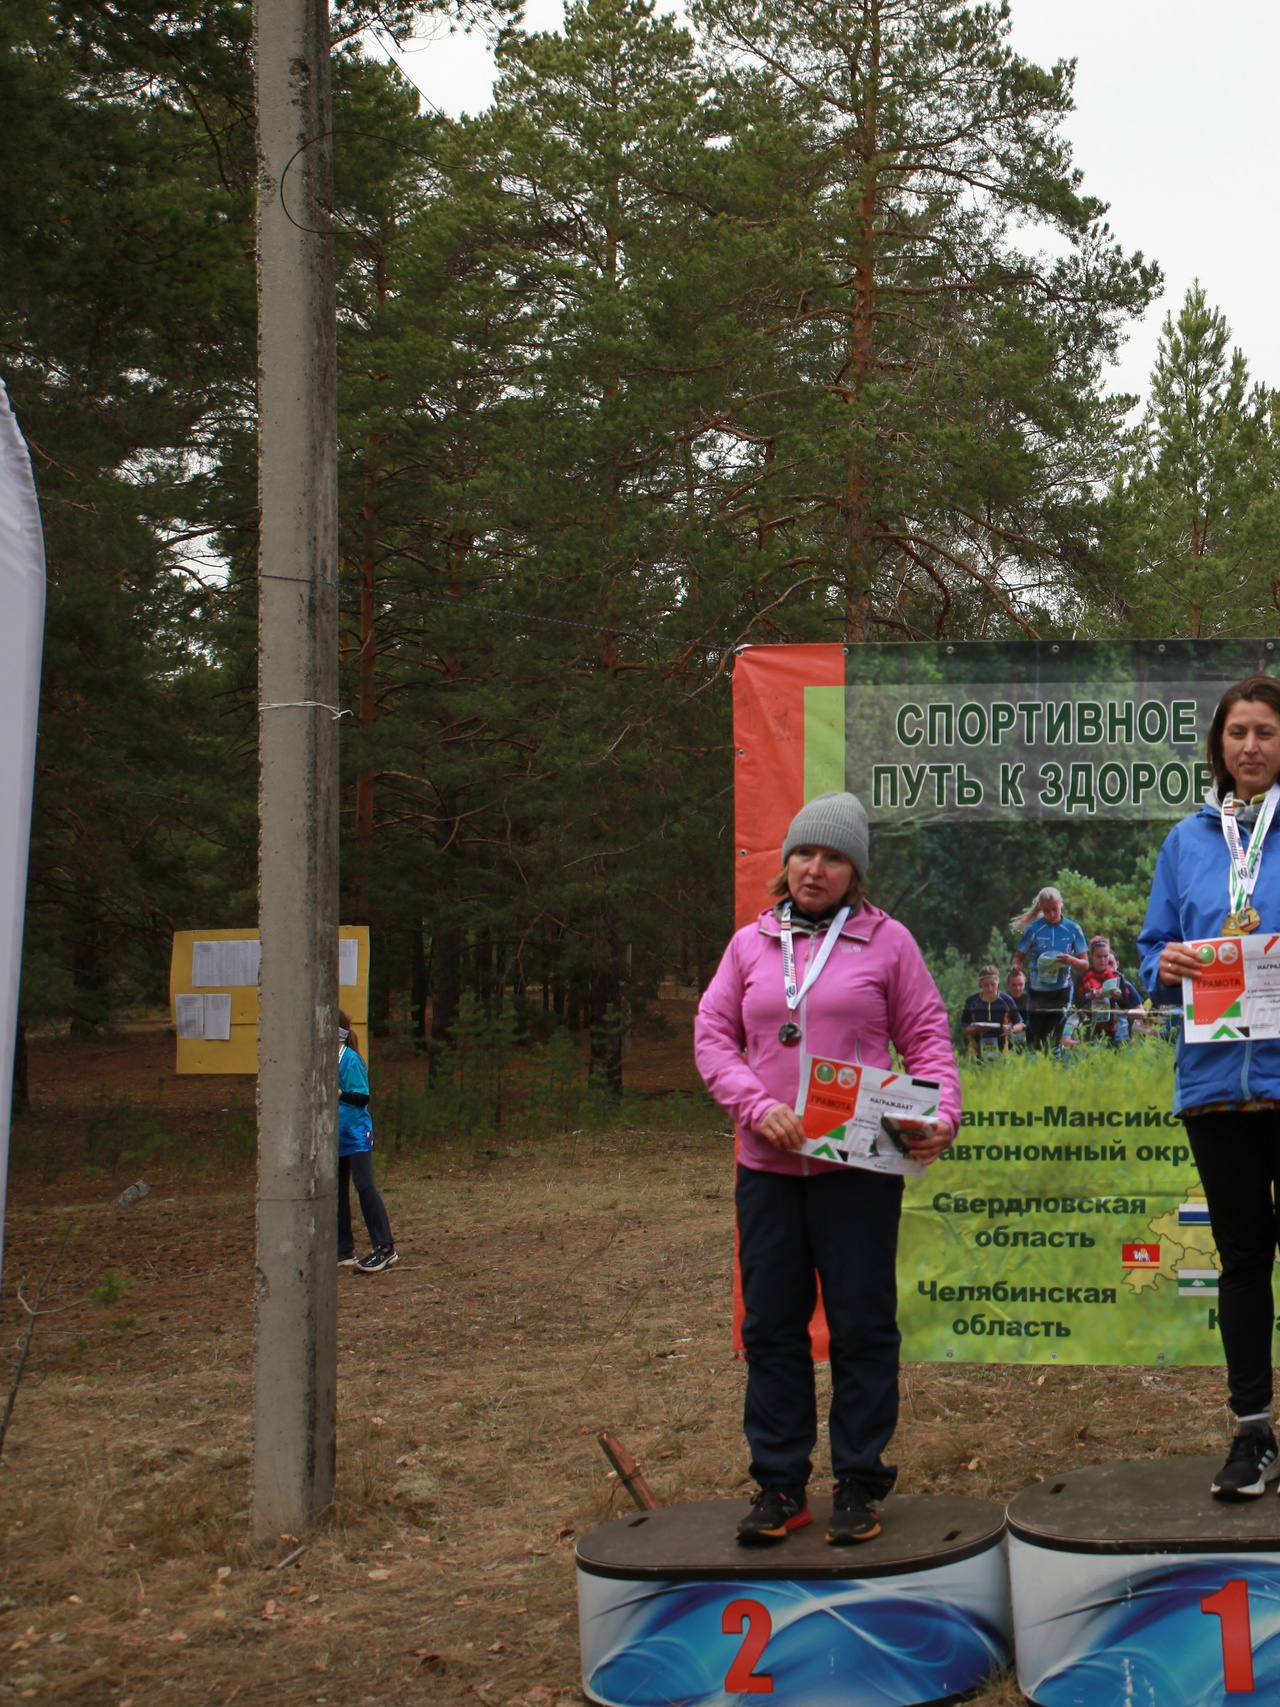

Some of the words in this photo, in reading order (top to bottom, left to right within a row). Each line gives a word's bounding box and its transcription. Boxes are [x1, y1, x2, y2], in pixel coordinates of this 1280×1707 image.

[896, 700, 1198, 747] СПОРТИВНОЕ
[873, 763, 984, 808] ПУТЬ
[1000, 762, 1025, 807] К
[1196, 978, 1241, 988] ГРАМОТА
[810, 1095, 852, 1111] ГРАМОТА
[870, 1097, 913, 1111] НАГРАЖДАЕТ
[960, 1105, 1187, 1128] анты-Мансийс
[938, 1138, 1126, 1161] автономный
[1136, 1144, 1197, 1167] окр
[932, 1192, 1146, 1218] Свердловская
[974, 1226, 1096, 1248] область
[917, 1280, 1117, 1304] Челябинская
[952, 1313, 1072, 1338] область
[722, 1598, 774, 1693] 2
[1201, 1578, 1255, 1692] 1
